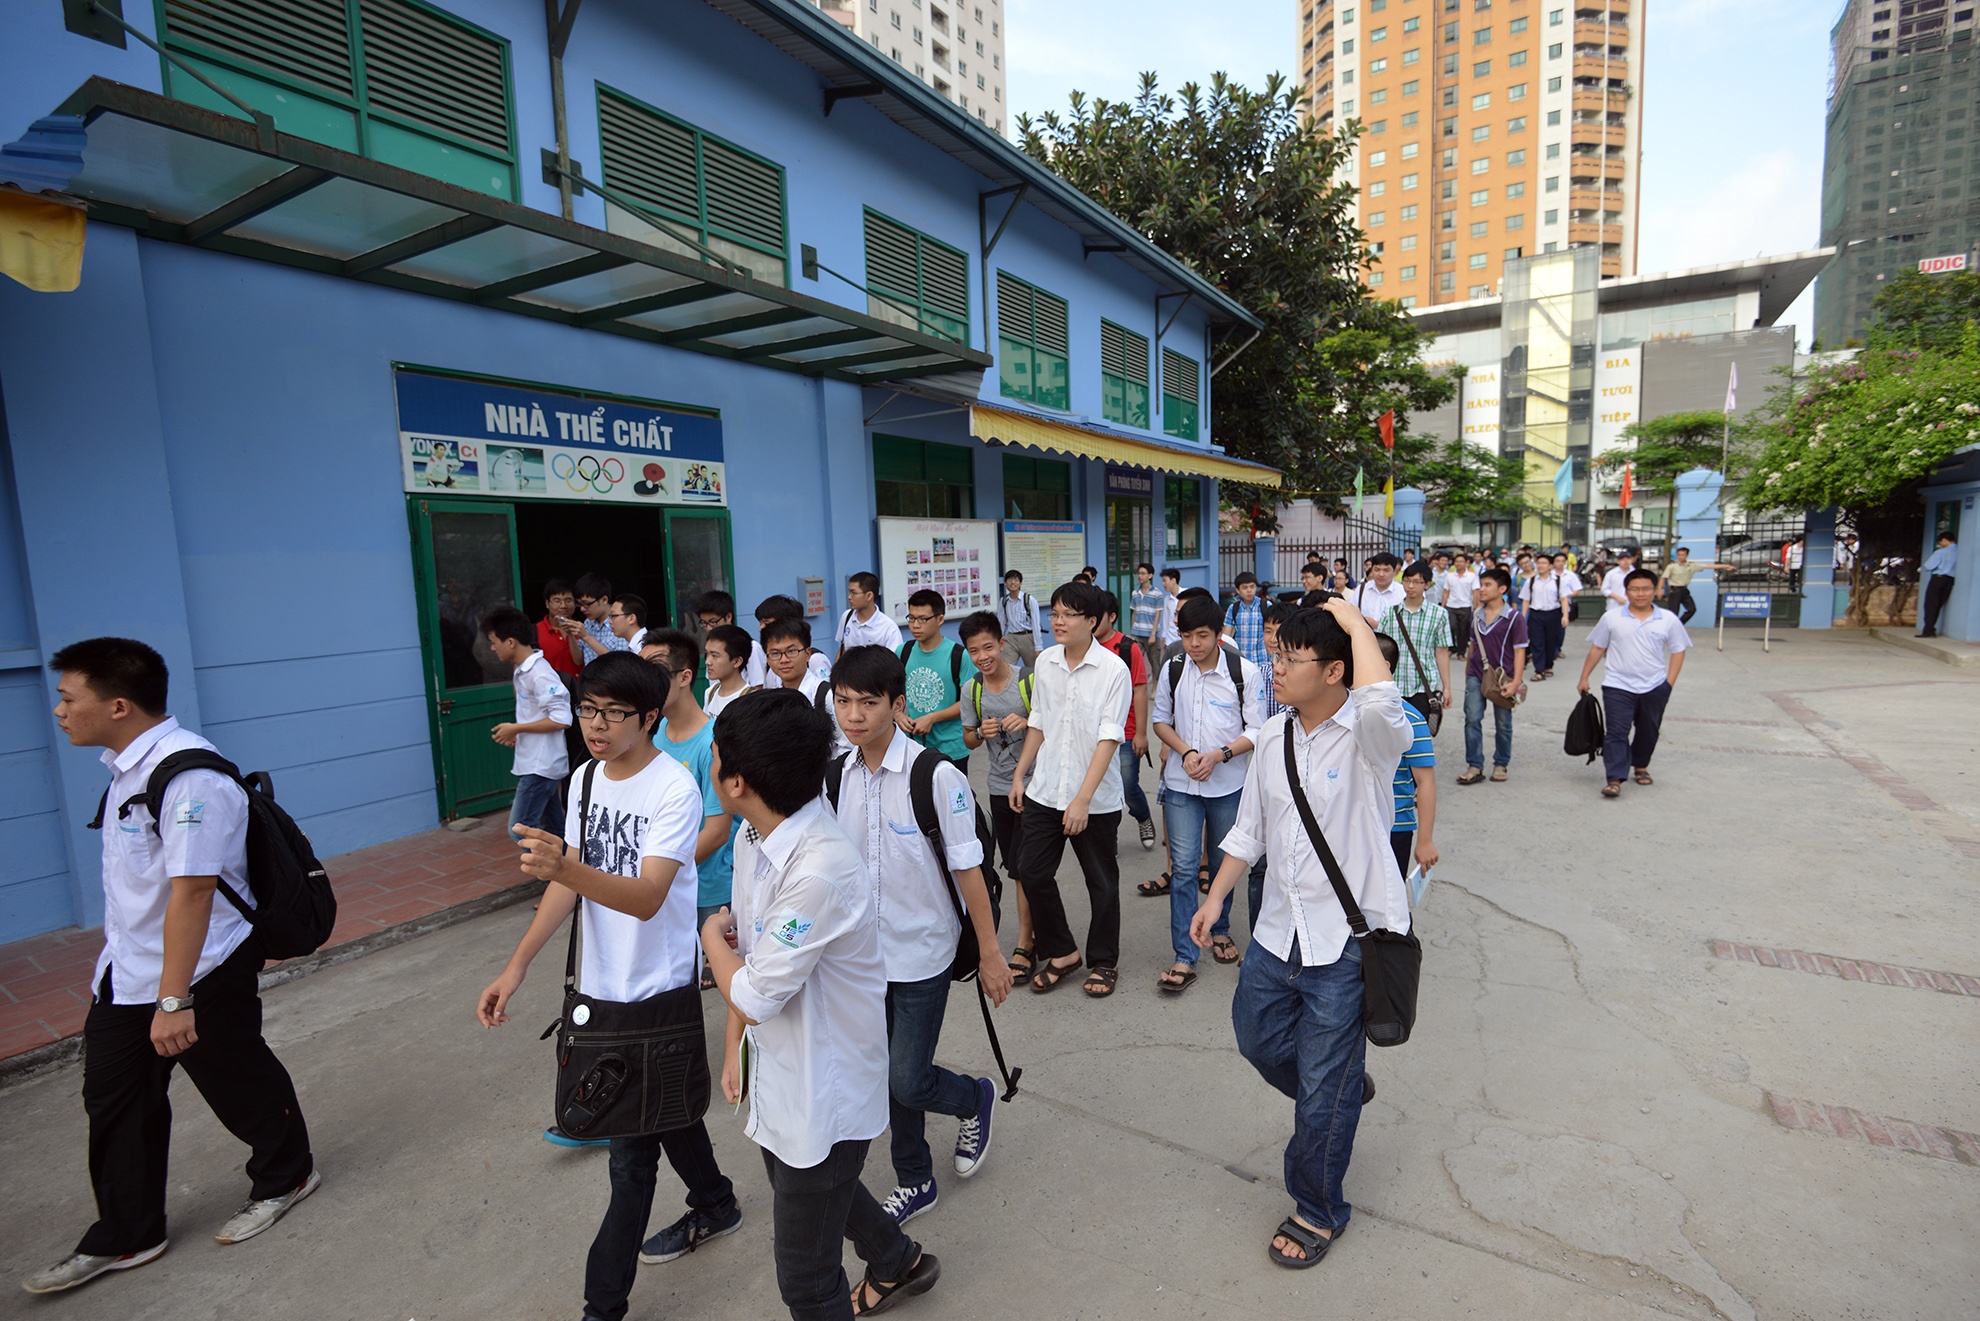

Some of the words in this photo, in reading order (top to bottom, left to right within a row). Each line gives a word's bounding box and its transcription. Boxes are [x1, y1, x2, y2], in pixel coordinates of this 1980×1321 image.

[1921, 256, 1963, 273] UDIC
[1605, 358, 1630, 369] BIA
[1471, 371, 1496, 384] NHÀ
[1601, 385, 1633, 397] TƯƠI
[1601, 411, 1631, 423] TIỆP
[484, 402, 549, 438] NHÀ
[555, 406, 606, 444] THỂ
[613, 415, 673, 452] CHẤT
[1465, 423, 1499, 434] PLZEN
[410, 438, 453, 457] YONX
